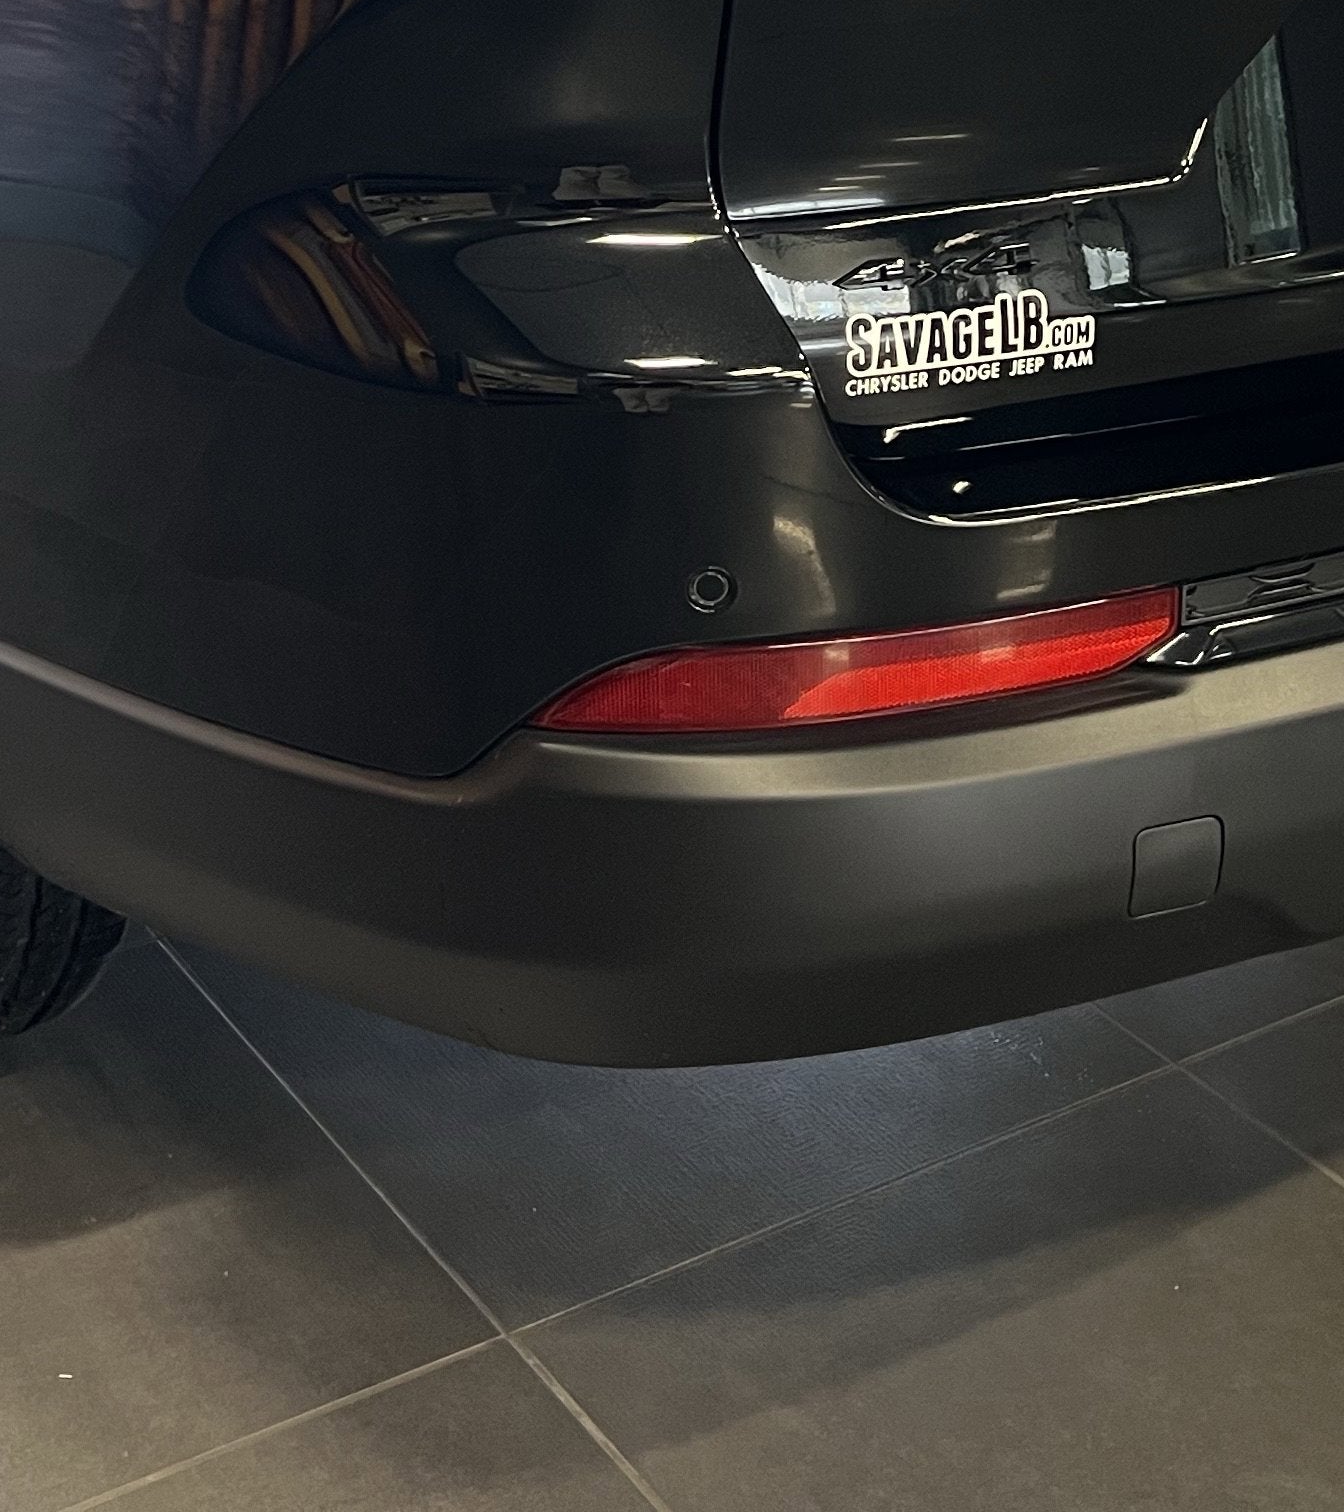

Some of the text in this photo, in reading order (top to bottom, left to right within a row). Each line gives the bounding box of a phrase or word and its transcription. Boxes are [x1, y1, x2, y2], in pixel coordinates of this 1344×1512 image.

[845, 349, 1094, 397] CHRYSLER DODGE JEEP RAM
